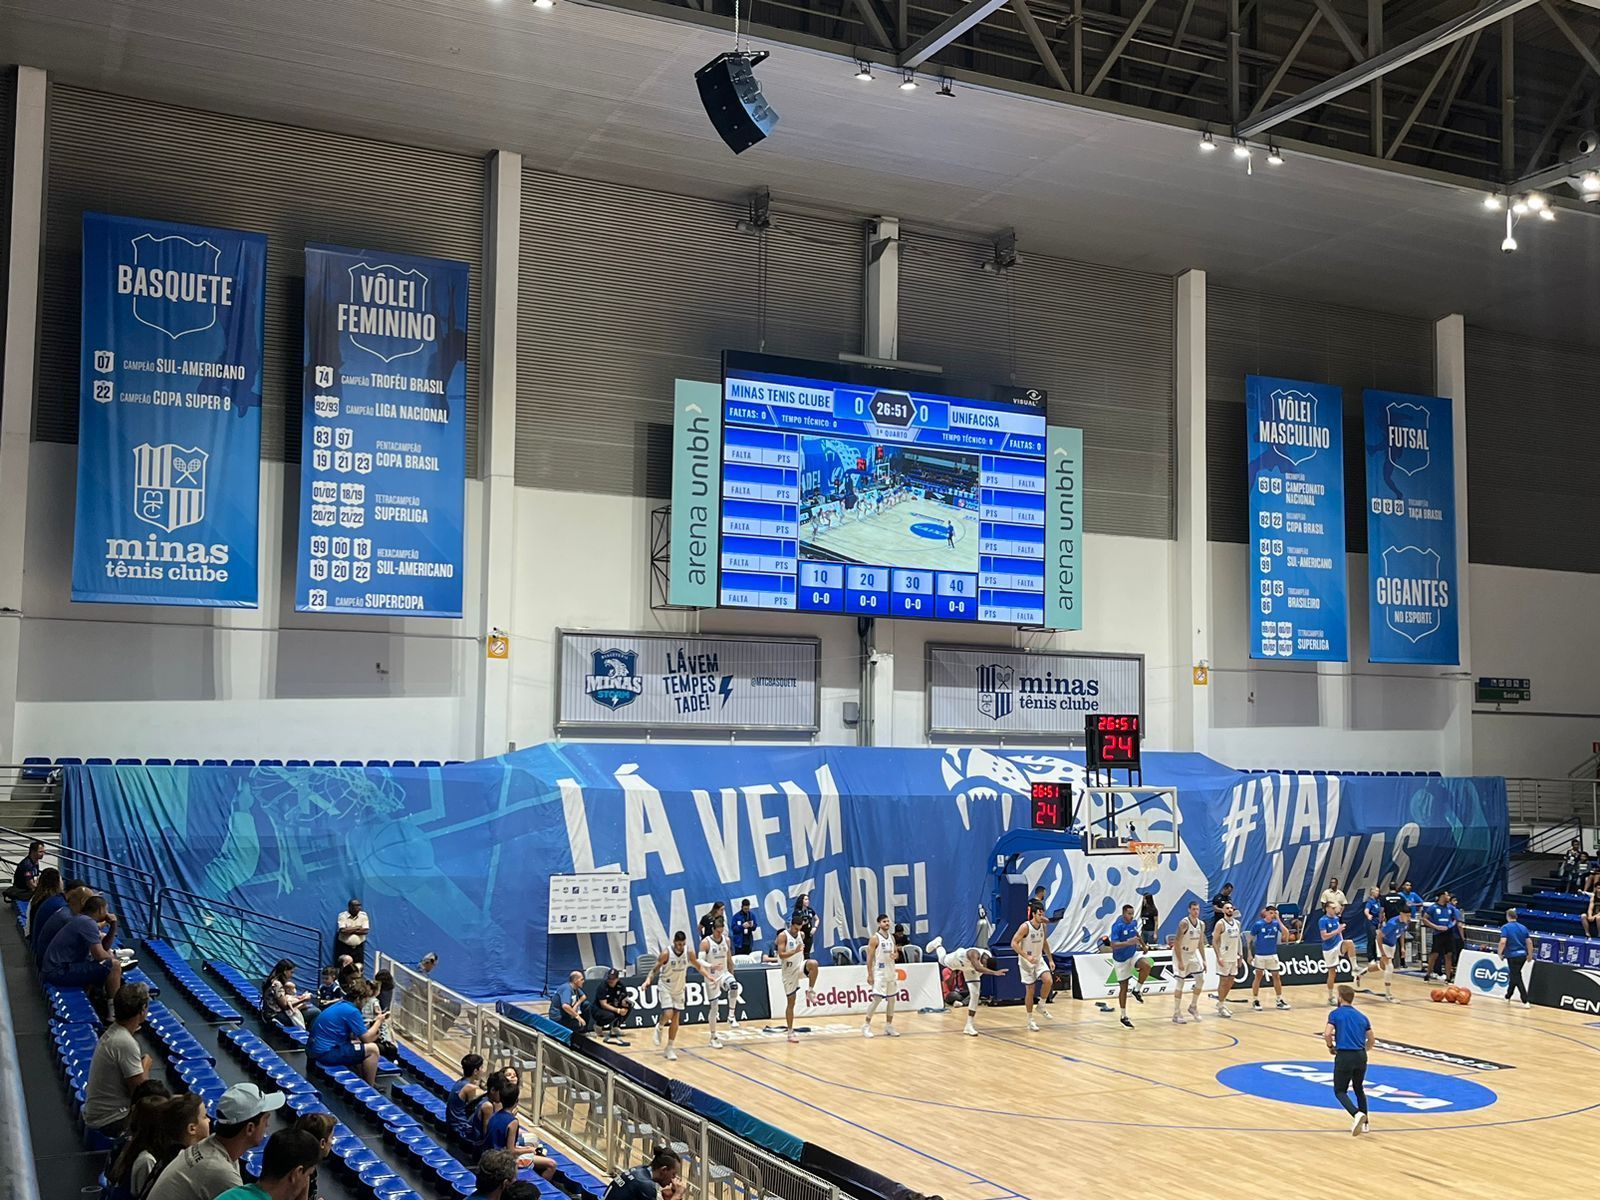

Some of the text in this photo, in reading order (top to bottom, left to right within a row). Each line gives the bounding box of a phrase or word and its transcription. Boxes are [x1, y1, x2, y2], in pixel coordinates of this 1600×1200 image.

[118, 265, 232, 306] BASQUETE
[361, 273, 414, 308] VÔLEI
[338, 304, 436, 342] FEMININO
[97, 355, 111, 370] 07
[156, 358, 245, 380] SUL-AMERICANO
[320, 371, 330, 384] 74
[371, 370, 408, 390] TROFÉU
[410, 377, 444, 395] BRASIL
[96, 385, 111, 399] 22
[152, 390, 182, 408] COPA
[186, 394, 220, 410] SUPER
[224, 397, 231, 411] 8
[732, 384, 831, 408] MINAS TENIS CLUBE
[316, 400, 338, 413] 92/93
[376, 403, 398, 418] LIGA
[400, 406, 448, 424] NACIONAL
[730, 407, 758, 419] FALTAS:
[854, 397, 864, 414] 0
[876, 402, 907, 418] 26:51
[920, 405, 928, 422] 0
[1278, 396, 1311, 422] VÔLEI
[782, 414, 802, 424] TEMPO
[952, 411, 1000, 428] UNIFACISA
[316, 431, 350, 446] 83 97
[1260, 420, 1330, 449] MASCULINO
[1388, 426, 1429, 450] FUTSAL
[1010, 440, 1035, 450] FALTAS:
[316, 454, 370, 470] 19 21 23
[376, 452, 440, 472] COPA BRASIL
[732, 450, 790, 464] FALTA PTS
[986, 476, 1035, 488] PTS FALTA
[1286, 482, 1324, 496] CAMPEONATO
[314, 486, 362, 500] 01/02 18/19
[731, 486, 790, 498] FALTA PTS
[1286, 494, 1316, 506] NACIONAL
[686, 416, 710, 586] arena unibh
[313, 510, 362, 524] 20/21 21/22
[375, 506, 428, 524] SUPERLIGA
[986, 510, 998, 518] PTS
[730, 522, 789, 534] FALTA PTS
[1056, 459, 1074, 610] arena unibh
[1286, 522, 1302, 534] COPA
[1304, 523, 1324, 534] BRASIL
[106, 533, 229, 564] minas
[313, 540, 368, 556] 99 00 18
[985, 543, 1034, 554] PTS FALTA
[105, 560, 228, 582] tênis clube
[314, 564, 368, 579] 19 20 22
[377, 560, 454, 578] SUL-AMERICANO
[730, 558, 788, 570] FALTA PTS
[814, 570, 964, 592] 1Q 2Q 3Q 4Q
[984, 576, 1034, 587] PTS FALTA
[728, 594, 788, 606] FALTA PTS
[1376, 577, 1448, 608] GIGANTES
[311, 594, 324, 606] 23
[365, 594, 424, 610] SUPERCOPA
[813, 592, 964, 612] 0-0 0-0 0-0 0-0
[984, 610, 1034, 620] PTS FALTA
[1298, 639, 1330, 650] SUPERLIGA
[666, 648, 718, 676] LÁ VEM
[586, 676, 642, 694] MINAS
[662, 674, 716, 696] TEMPES
[1019, 672, 1099, 696] minas
[674, 693, 711, 714] TADE!
[1019, 696, 1098, 712] tênis clube
[1098, 717, 1138, 730] 26:51
[1102, 735, 1132, 760] 24
[1033, 784, 1059, 798] 26:51
[1036, 802, 1056, 825] 24
[1222, 774, 1340, 870] #VAI
[556, 763, 842, 884] LÁ VEM
[1267, 822, 1420, 916] MINAS
[1474, 968, 1508, 982] EMS
